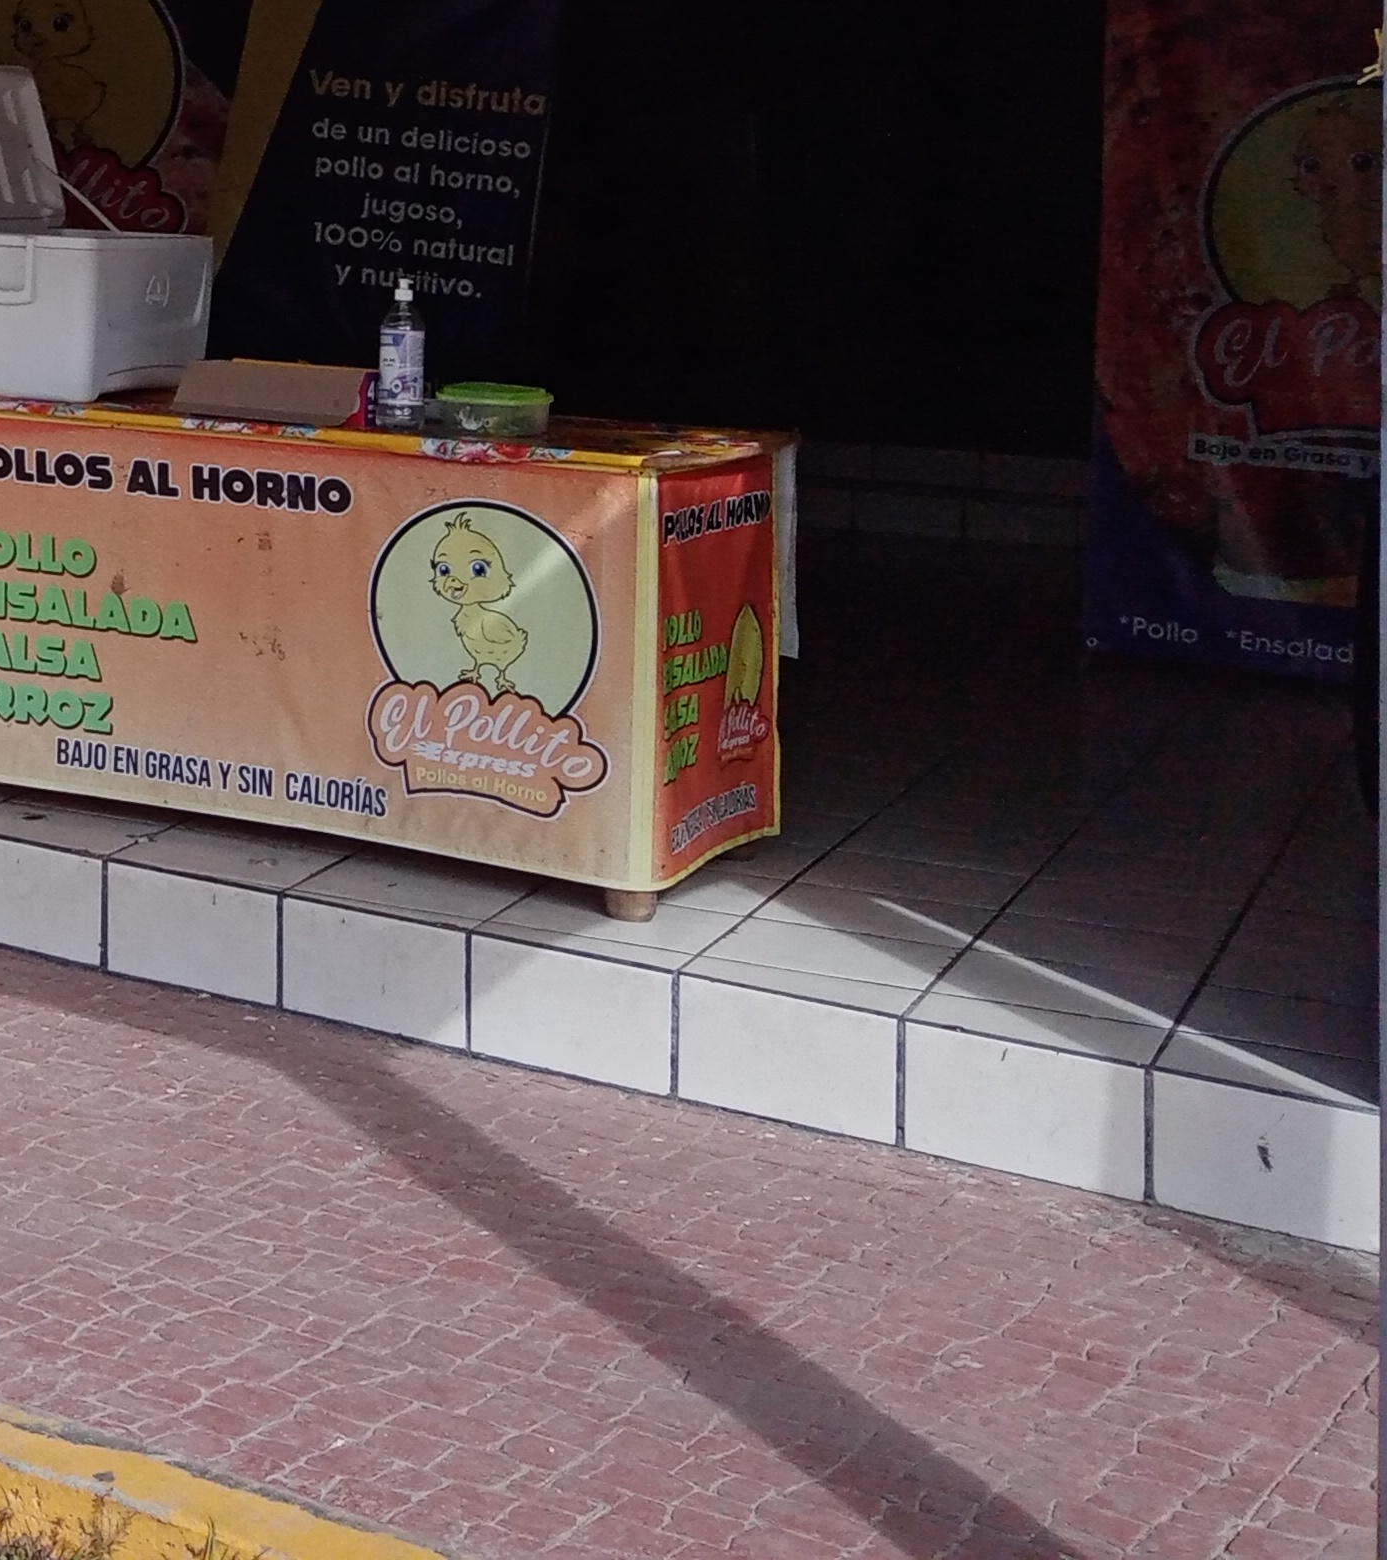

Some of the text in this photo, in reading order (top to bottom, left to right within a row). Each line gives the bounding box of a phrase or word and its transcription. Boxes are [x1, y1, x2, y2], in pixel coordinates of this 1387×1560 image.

[309, 68, 547, 116] Ven y disfruta
[311, 117, 531, 159] de un delicioso
[315, 156, 521, 199] pollo al horno,
[360, 192, 464, 230] jugoso,
[313, 221, 515, 267] 100% natural
[335, 263, 352, 286] y
[1213, 315, 1289, 388] El
[1194, 439, 1371, 471] Bajo en Grasa y
[125, 457, 180, 500] AL
[189, 464, 354, 516] HORNO
[1225, 627, 1355, 665] Ensalad
[379, 693, 433, 753] El
[443, 694, 592, 778] Pollito
[55, 738, 387, 818] BAJO EN GRASA Y SIN CALORÍAS
[413, 740, 538, 778] Express
[415, 766, 548, 803] Pollos al Horno
